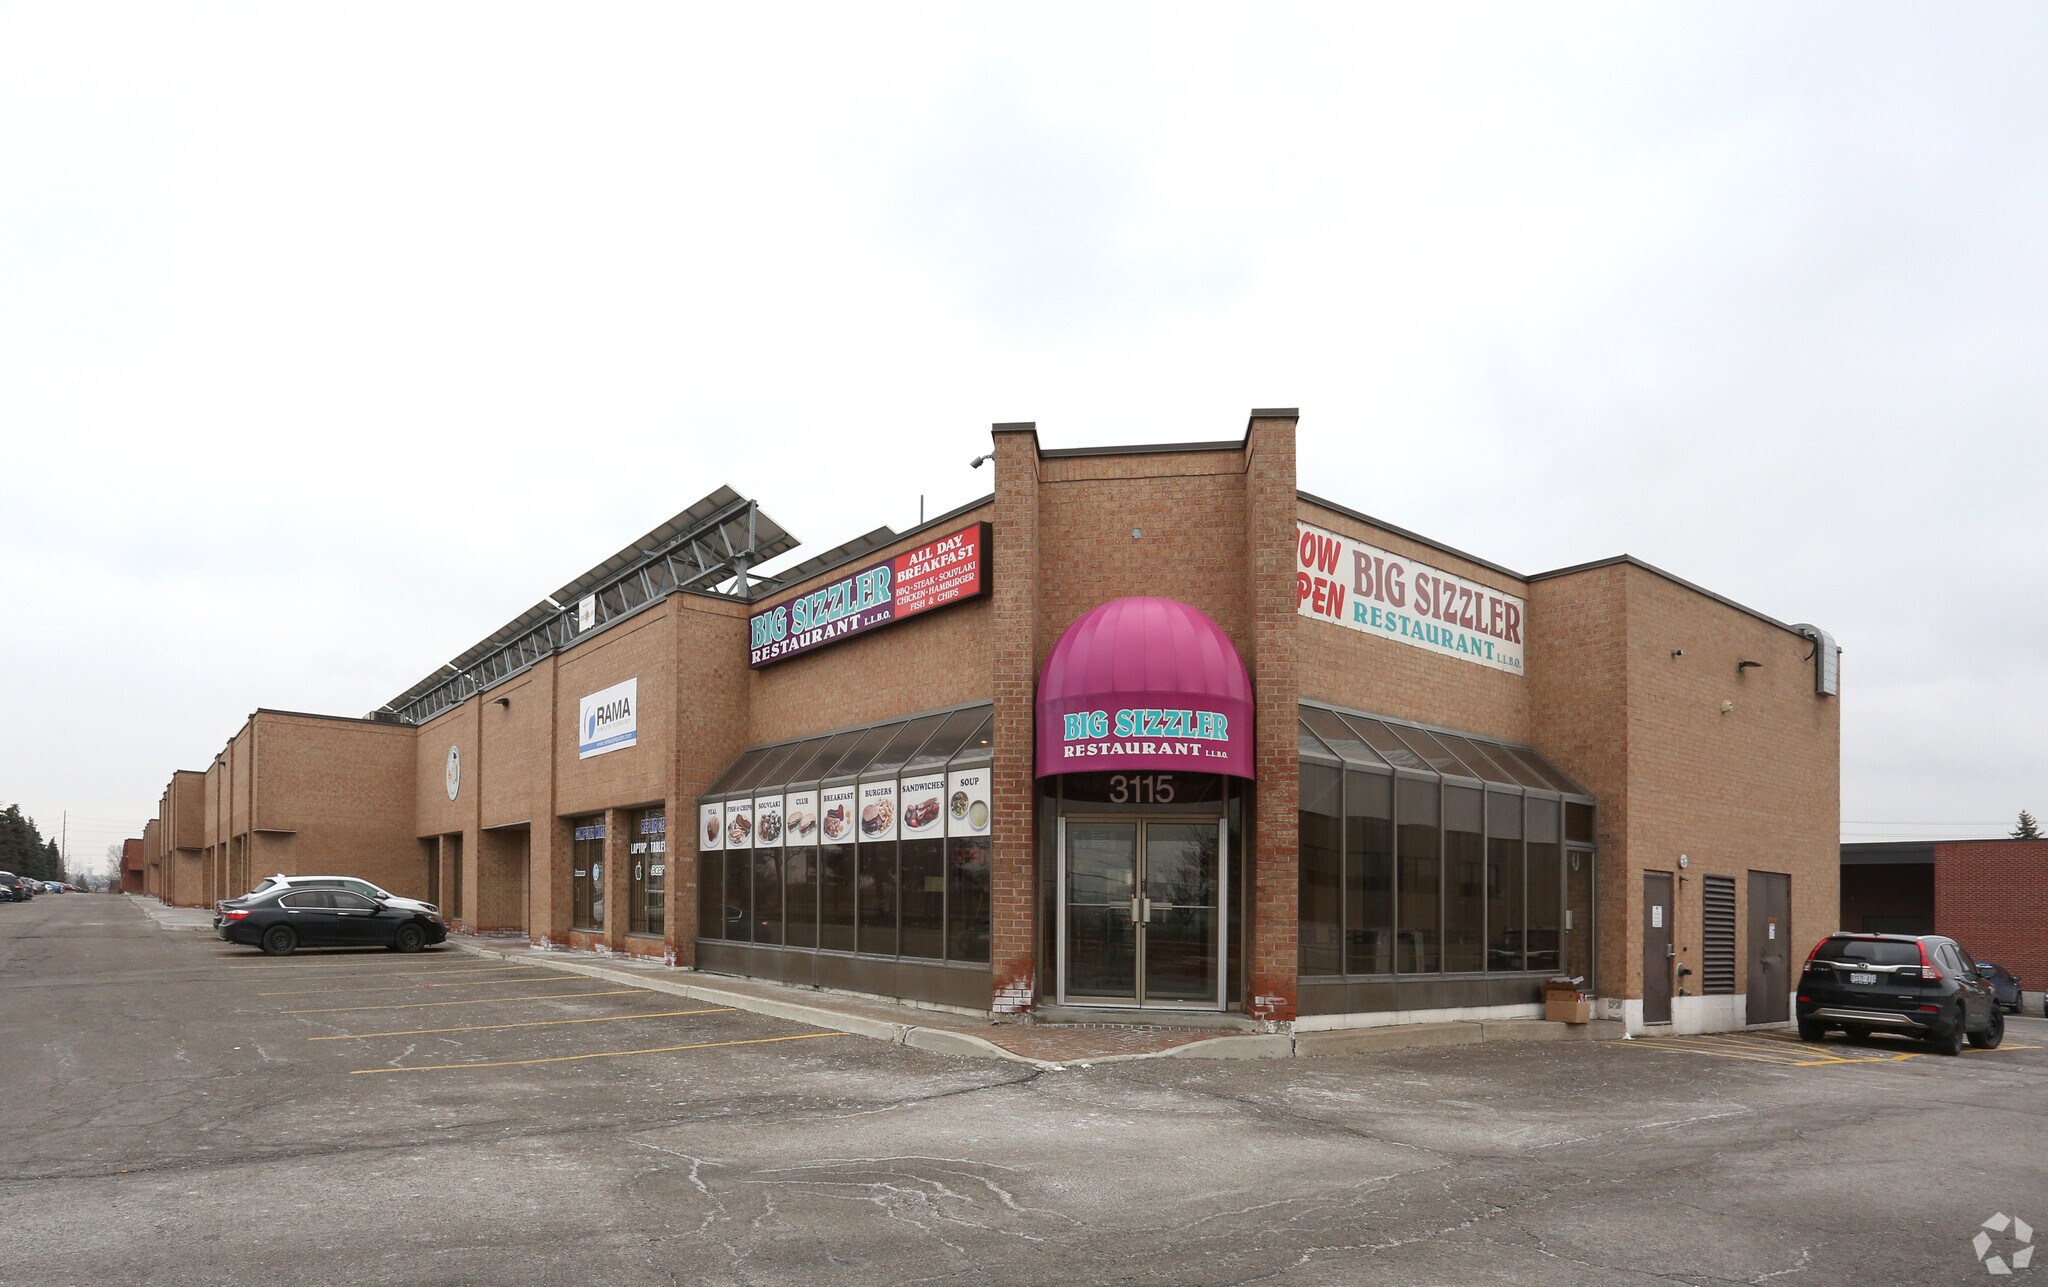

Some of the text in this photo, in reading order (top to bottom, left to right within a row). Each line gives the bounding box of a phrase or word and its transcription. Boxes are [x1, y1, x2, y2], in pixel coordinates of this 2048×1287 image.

[896, 543, 975, 583] BREAKFAST
[909, 534, 963, 566] ALL DAY
[1297, 528, 1341, 576] OW
[896, 561, 976, 597] BBQ STEAK SOUVLAKI
[897, 573, 975, 606] CHICKEN HAMBURGER
[751, 565, 891, 650] BIG SIZZLER
[910, 588, 959, 612] FISH & CHIPS
[1297, 572, 1345, 619] PEN
[1353, 549, 1521, 645] BIG SIZZLER
[751, 610, 891, 664] RESTAURANT L.L.B.O.
[1353, 601, 1495, 660] RESTAURANT
[597, 697, 631, 727] RAMA
[1064, 708, 1229, 741] BIG SIZZLER
[1064, 742, 1202, 758] RESTAURANT
[865, 787, 892, 798] BURGERS
[902, 781, 945, 793] SANDWICHES
[960, 777, 980, 787] SOUP
[1109, 775, 1175, 803] 3115
[741, 804, 753, 812] CHIPS
[758, 800, 781, 810] SOUVLAKI
[795, 797, 809, 806] CLUB
[823, 792, 854, 803] BREAKFAST
[630, 842, 647, 854] LAPTOP
